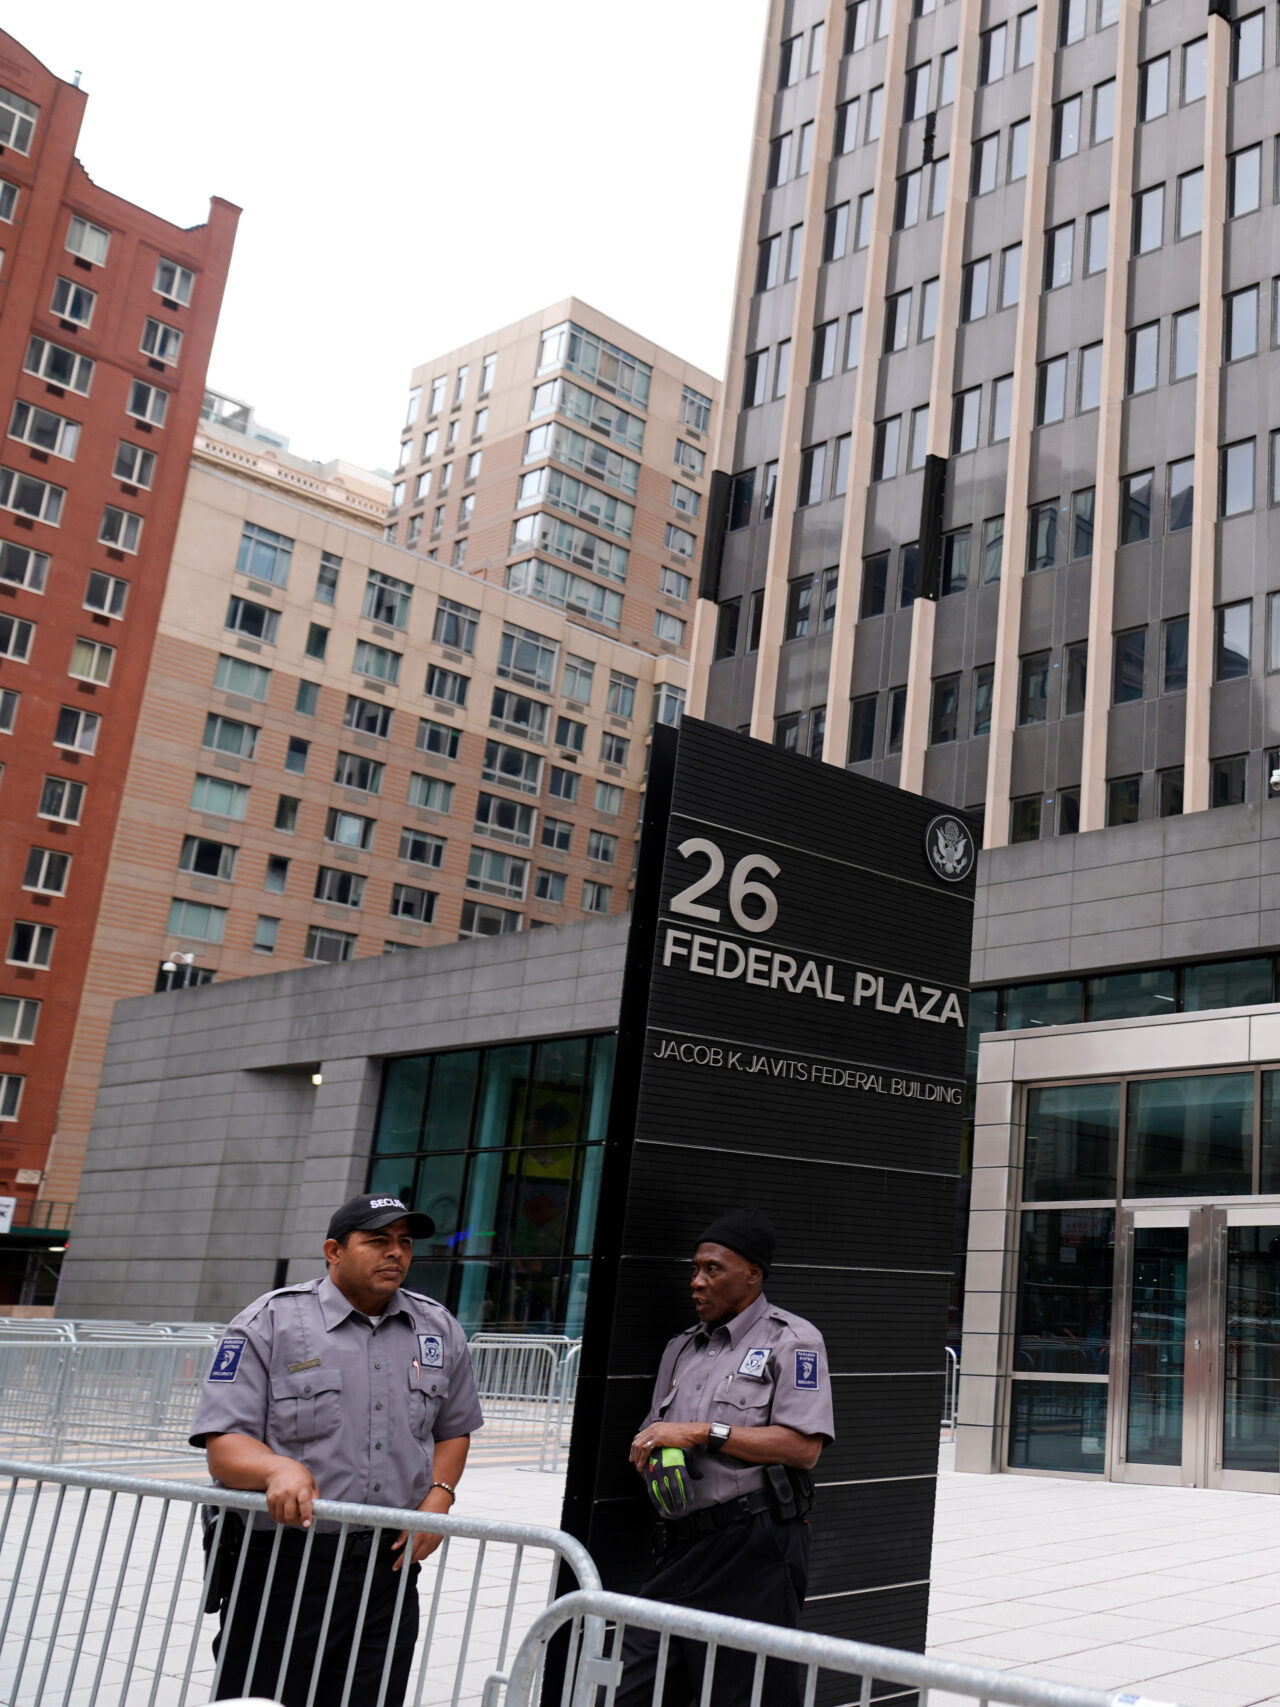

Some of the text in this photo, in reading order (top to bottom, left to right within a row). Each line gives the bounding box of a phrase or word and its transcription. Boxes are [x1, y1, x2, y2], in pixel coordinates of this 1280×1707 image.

[669, 837, 781, 933] 26
[662, 929, 965, 1028] FEDERAL PLAZA
[653, 1040, 963, 1105] JACOB K. JAVITS FEDERAL BUILDING
